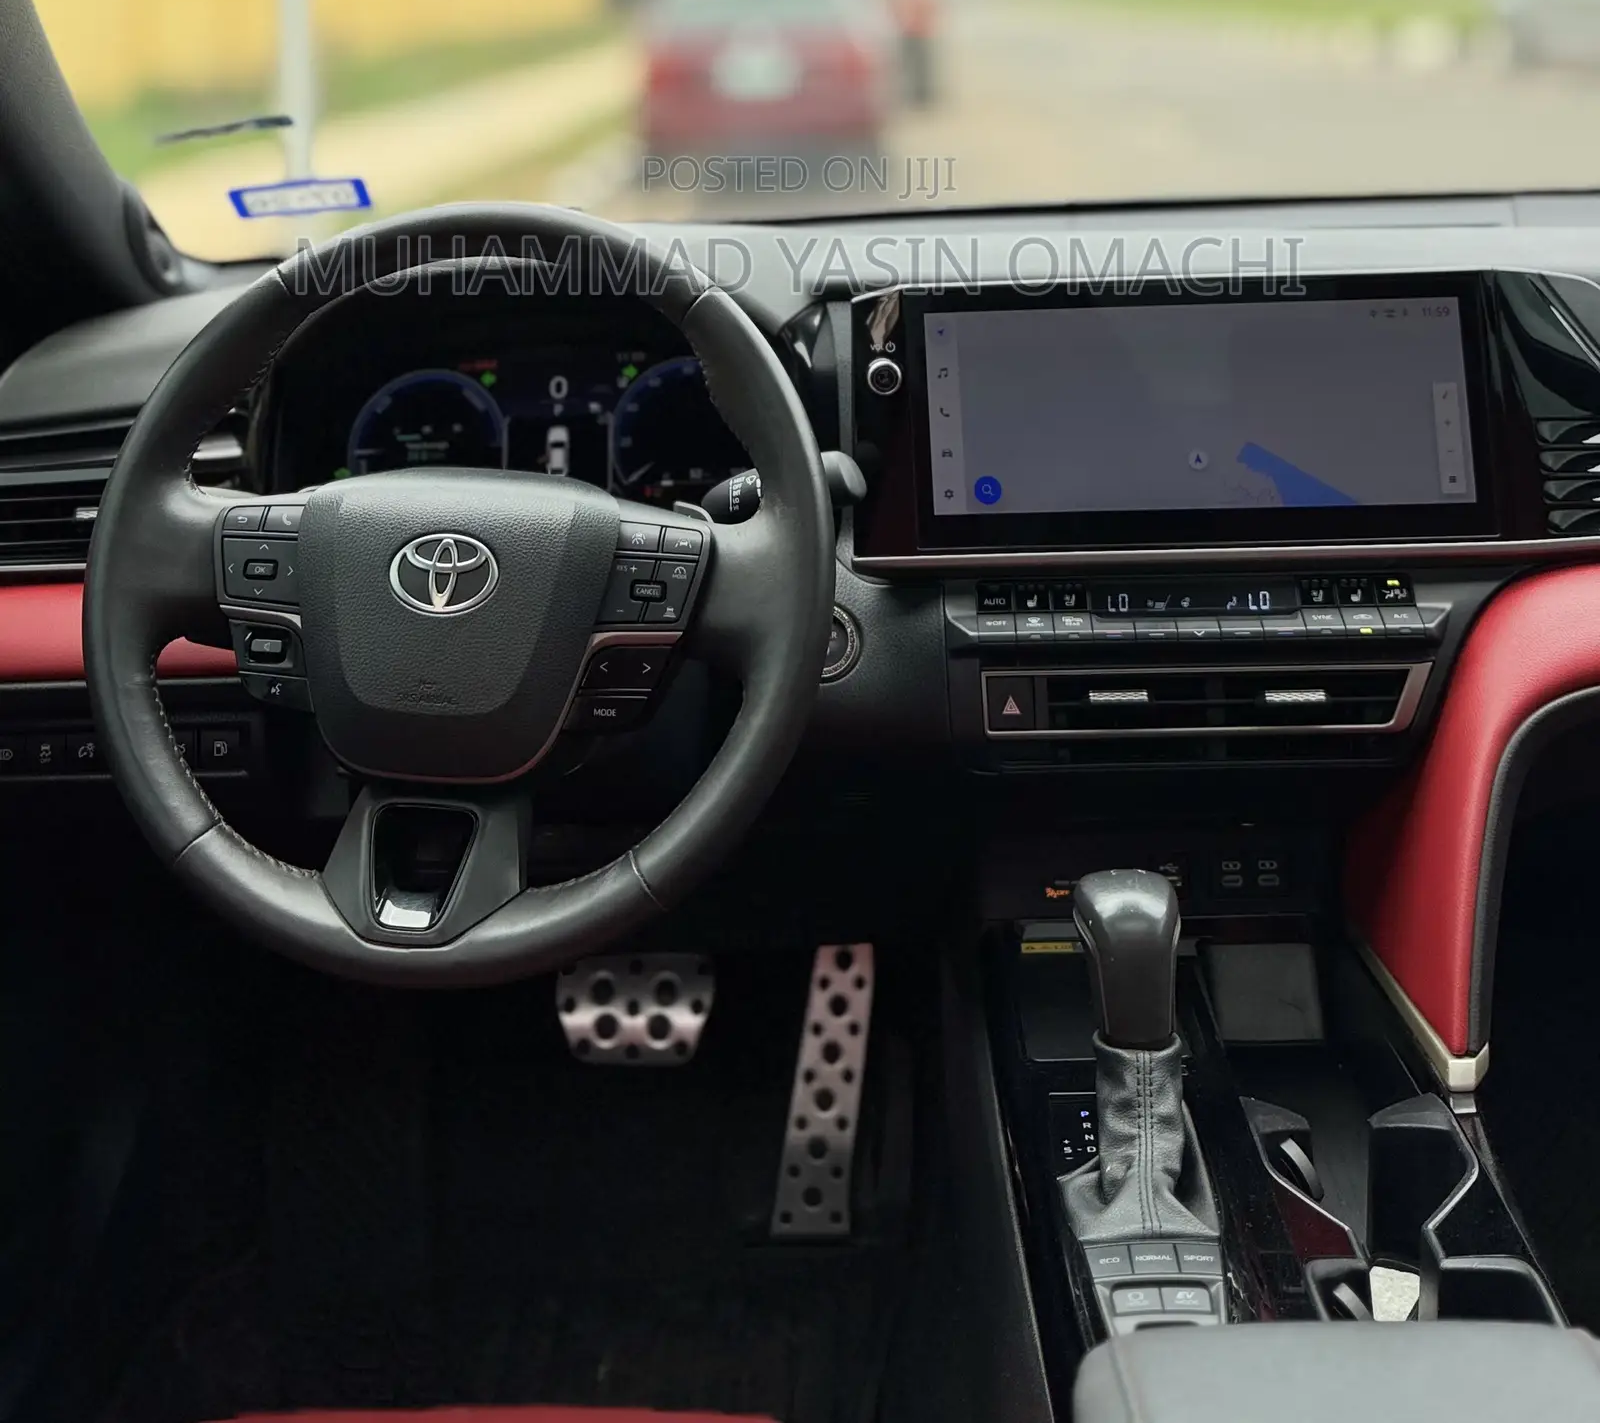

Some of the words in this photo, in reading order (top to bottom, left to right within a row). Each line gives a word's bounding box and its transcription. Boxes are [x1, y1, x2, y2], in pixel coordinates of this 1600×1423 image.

[254, 565, 267, 574] OK
[635, 587, 661, 597] CANCEL
[983, 597, 1007, 606] AUTO
[593, 707, 617, 717] MODE
[1080, 1110, 1090, 1118] P
[1086, 1145, 1097, 1153] D
[1135, 1254, 1173, 1262] NORMAL
[1183, 1254, 1215, 1262] SPORT
[1175, 1291, 1196, 1300] EV
